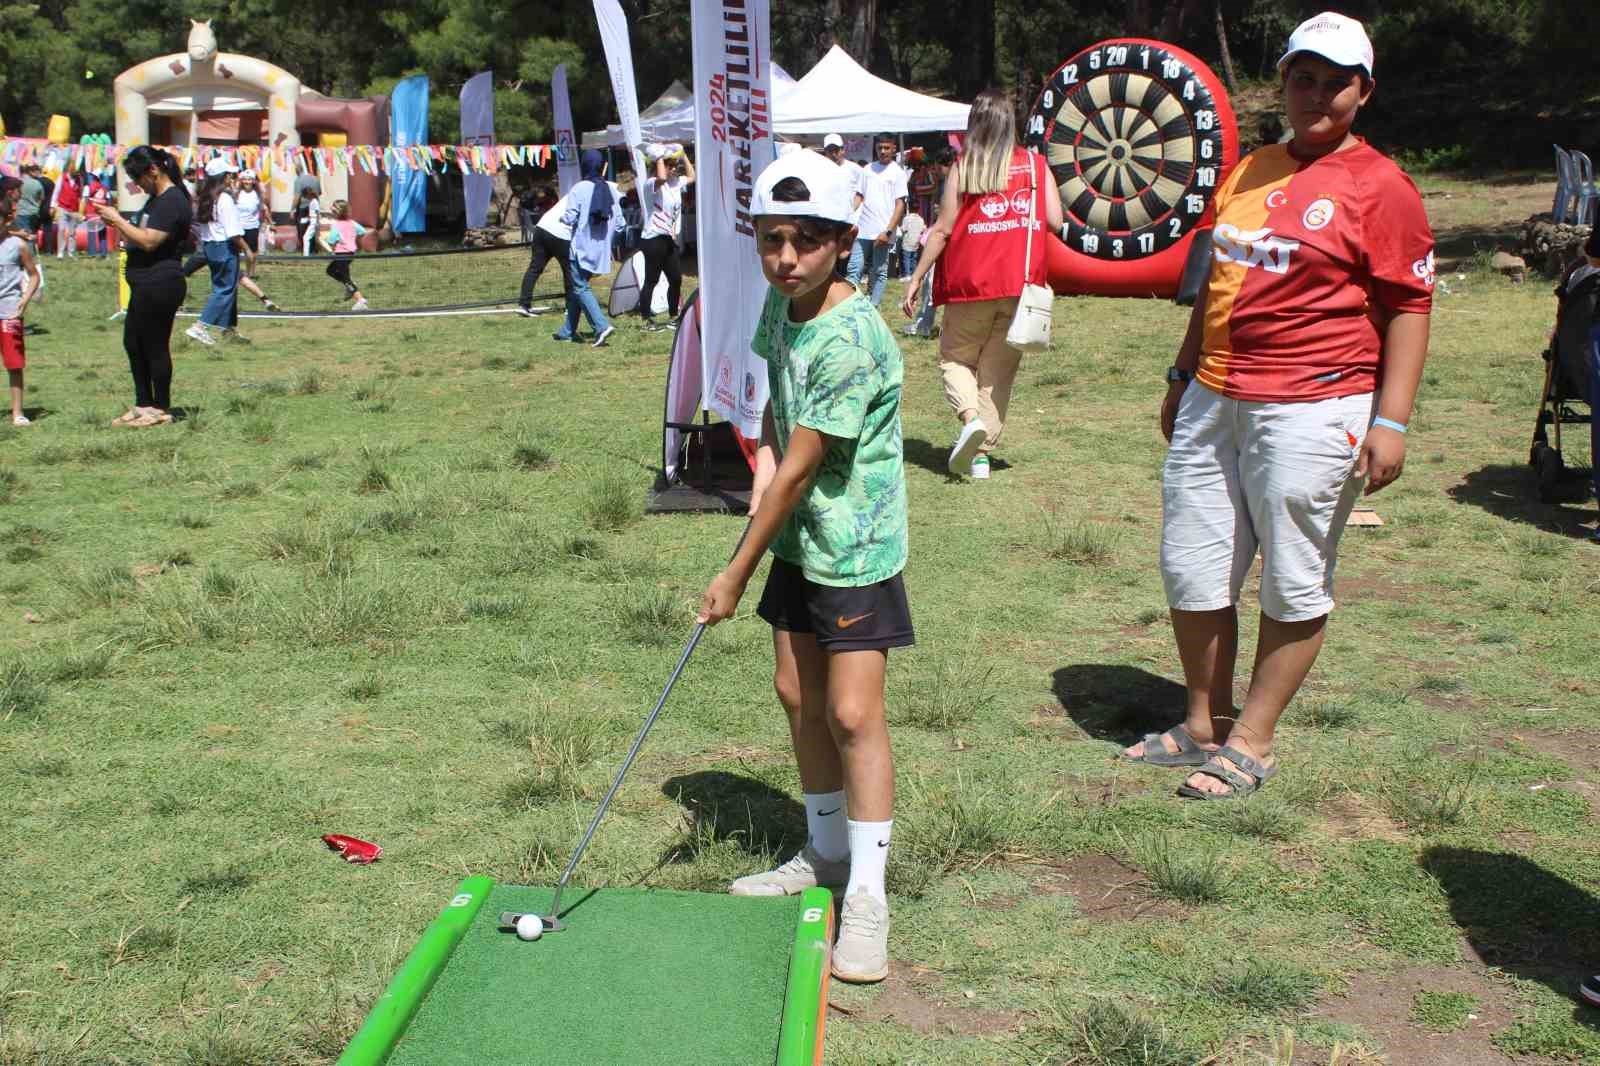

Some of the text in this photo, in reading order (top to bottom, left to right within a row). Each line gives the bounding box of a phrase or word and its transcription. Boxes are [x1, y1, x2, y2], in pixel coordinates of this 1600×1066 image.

[1089, 50, 1101, 69] 5
[1106, 46, 1128, 66] 20
[1140, 49, 1150, 70] 1
[1061, 63, 1079, 85] 12
[1161, 58, 1181, 79] 18
[1043, 90, 1054, 109] 9
[1182, 80, 1196, 100] 4
[709, 74, 727, 143] 2024
[751, 88, 769, 141] YILI
[723, 0, 755, 238] HAREKETLİLİ
[1028, 114, 1045, 134] 14
[1194, 109, 1214, 130] 13
[1200, 139, 1214, 159] 6
[1196, 166, 1216, 187] 10
[1185, 193, 1205, 214] 15
[1169, 217, 1182, 237] 2
[1080, 233, 1099, 253] 19
[1112, 239, 1124, 257] 3
[1137, 232, 1154, 253] 17
[450, 894, 473, 907] 6
[803, 907, 823, 922] 6
